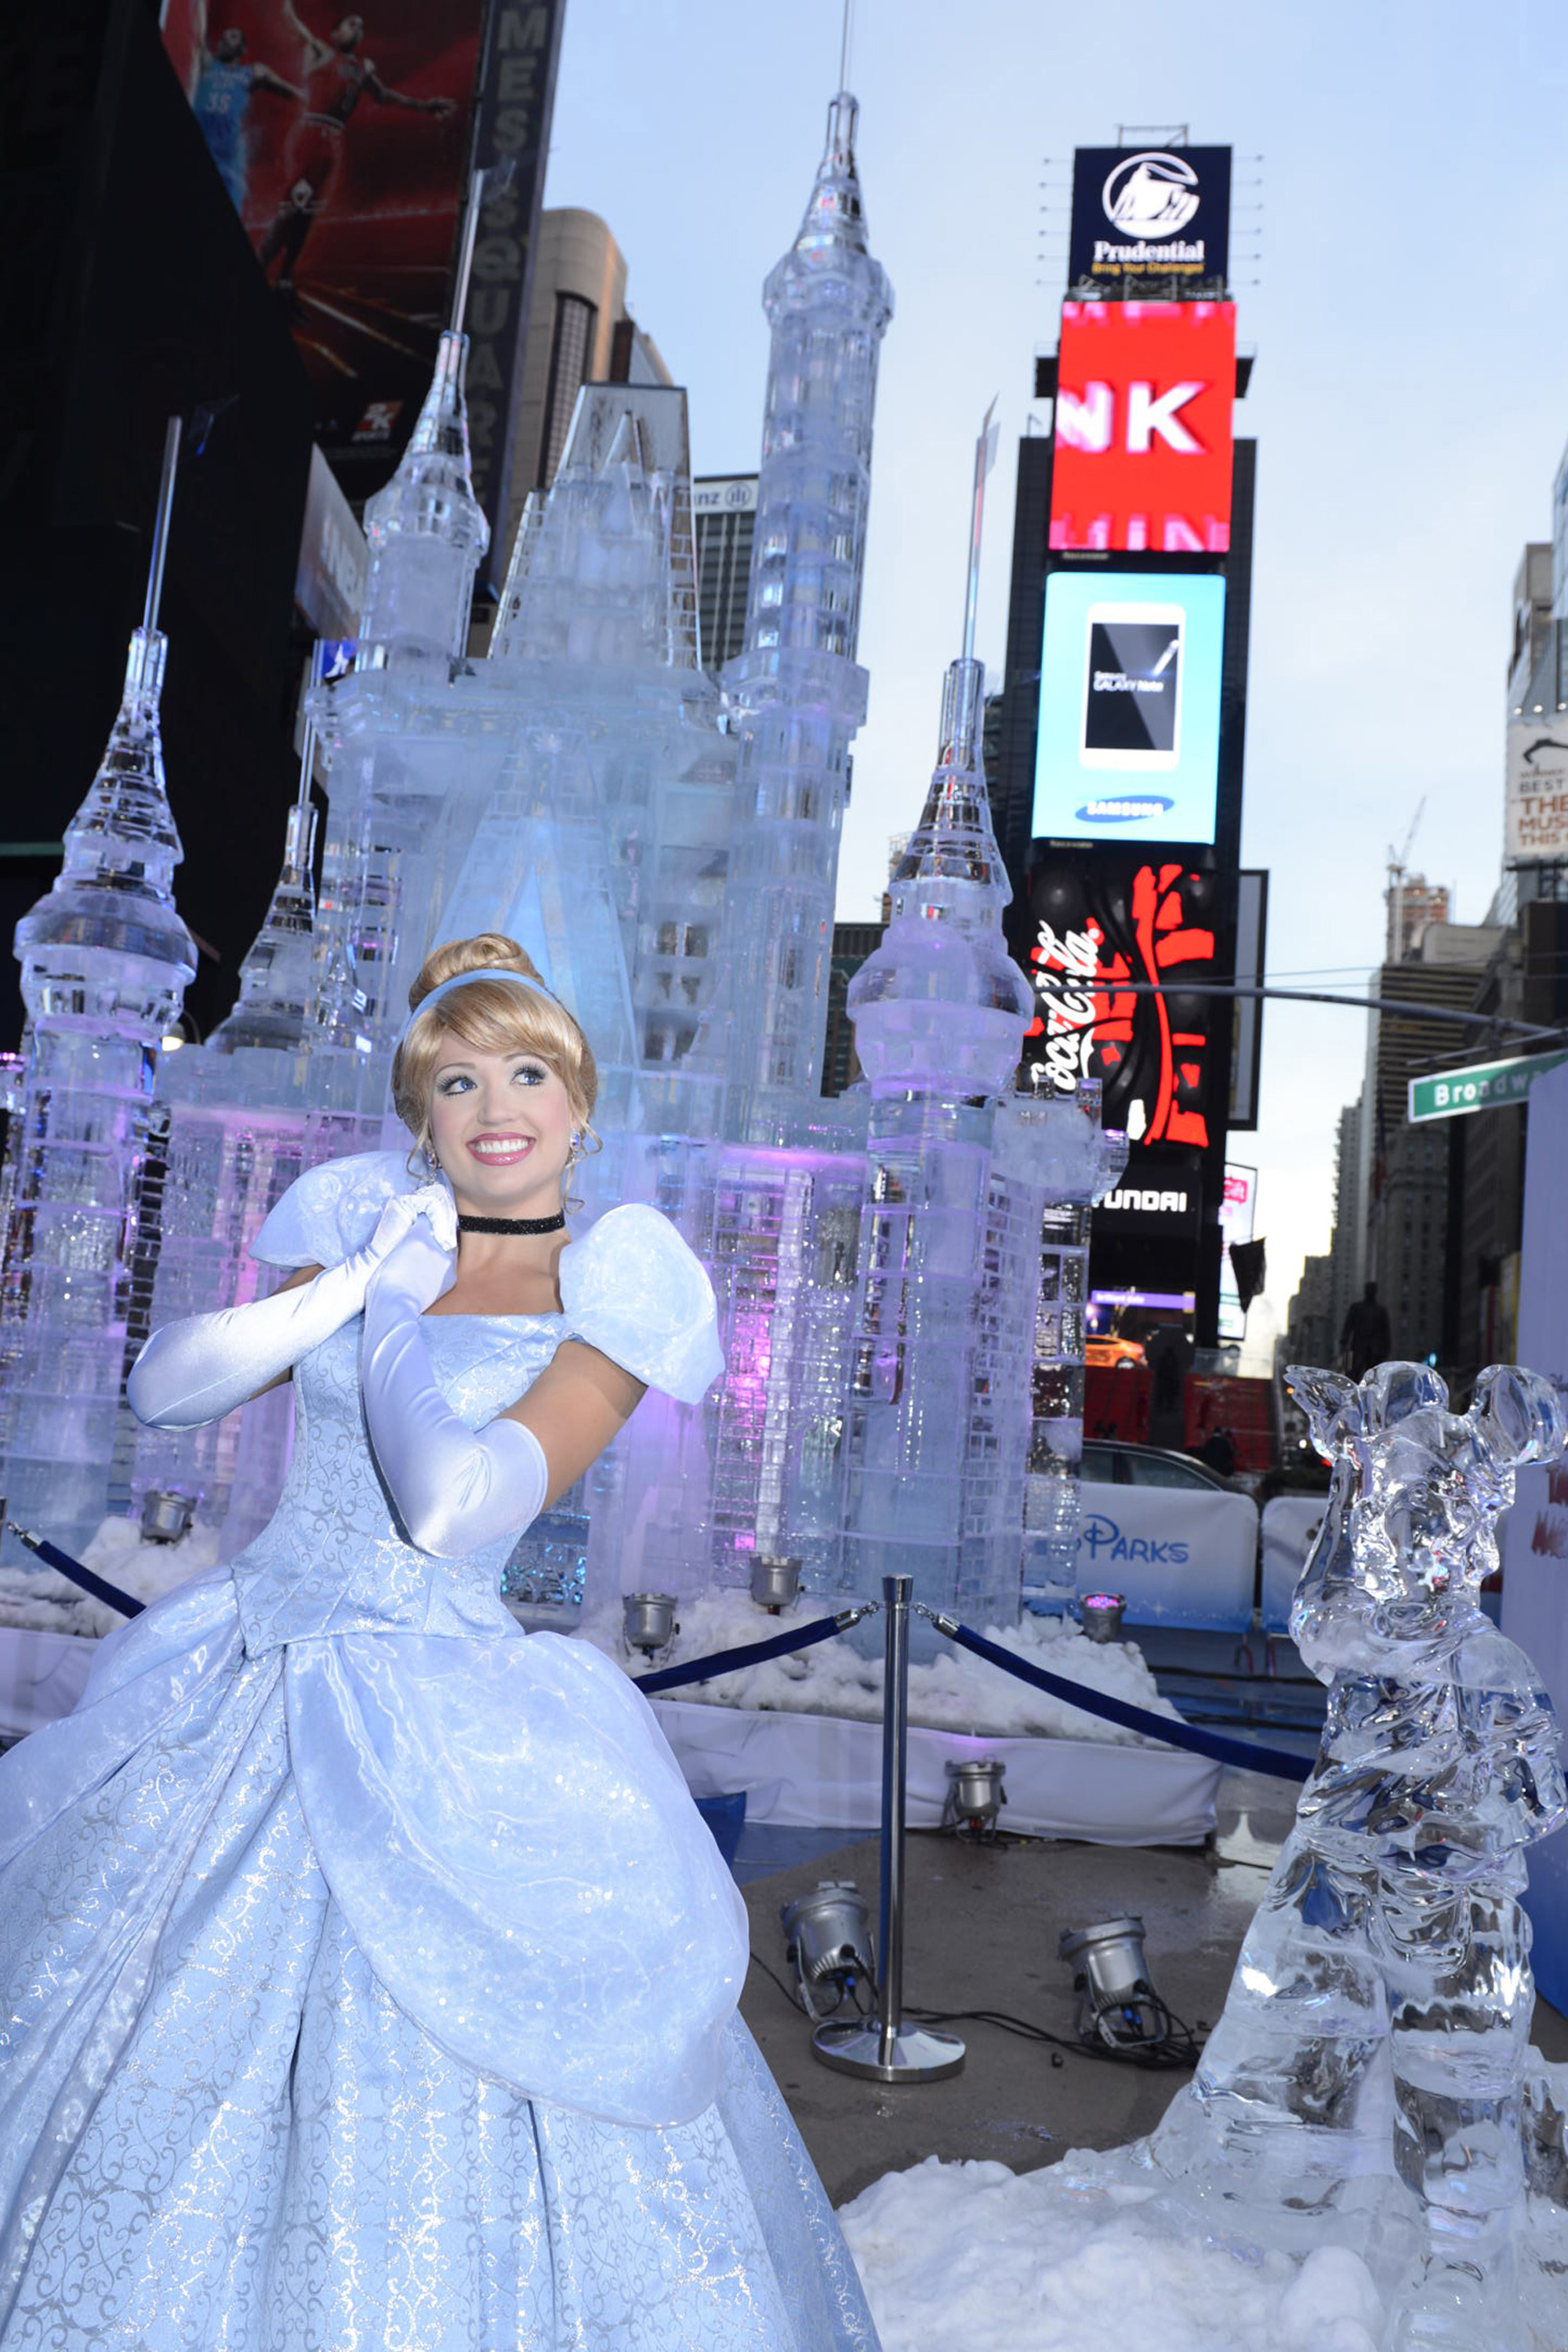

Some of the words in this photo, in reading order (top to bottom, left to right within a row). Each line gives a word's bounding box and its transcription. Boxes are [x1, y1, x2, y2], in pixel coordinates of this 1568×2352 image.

[492, 3, 548, 155] MES
[1093, 240, 1205, 263] Prudential
[1093, 679, 1136, 691] GALAXY
[1519, 778, 1564, 793] BEST
[1087, 800, 1164, 817] SAMSUNG
[1519, 793, 1568, 815] THE
[1519, 832, 1561, 846] THIS
[1092, 1189, 1188, 1212] UNDAI
[1083, 1514, 1190, 1563] PARKS
